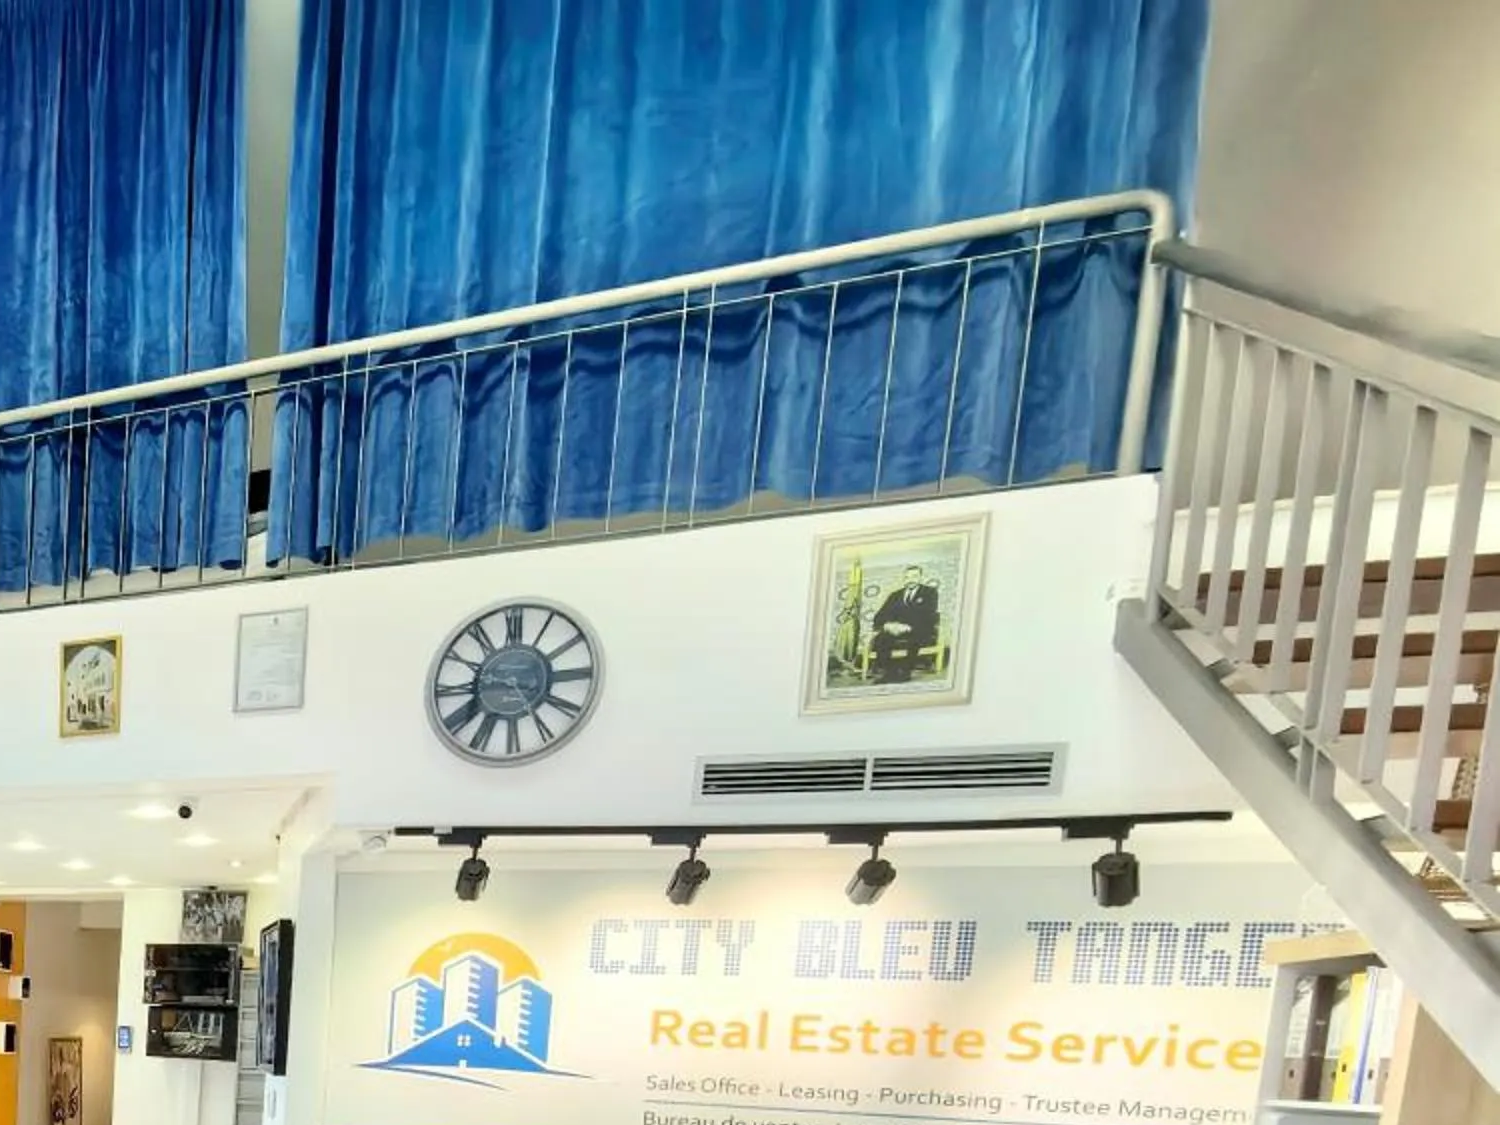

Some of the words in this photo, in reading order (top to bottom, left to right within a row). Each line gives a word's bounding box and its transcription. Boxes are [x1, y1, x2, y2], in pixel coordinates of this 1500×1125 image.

[590, 918, 756, 976] CITY
[794, 920, 977, 981] BLEU
[1026, 920, 1345, 988] TANGE
[650, 1009, 769, 1050] Real
[790, 1014, 985, 1060] Estate
[1004, 1020, 1261, 1072] Service
[645, 1075, 696, 1093] Sales
[700, 1076, 760, 1097] Office
[778, 1082, 859, 1106] Leasing
[879, 1086, 1002, 1112] Purchasing
[1023, 1095, 1111, 1116] Trustee
[1118, 1100, 1252, 1125] Managem
